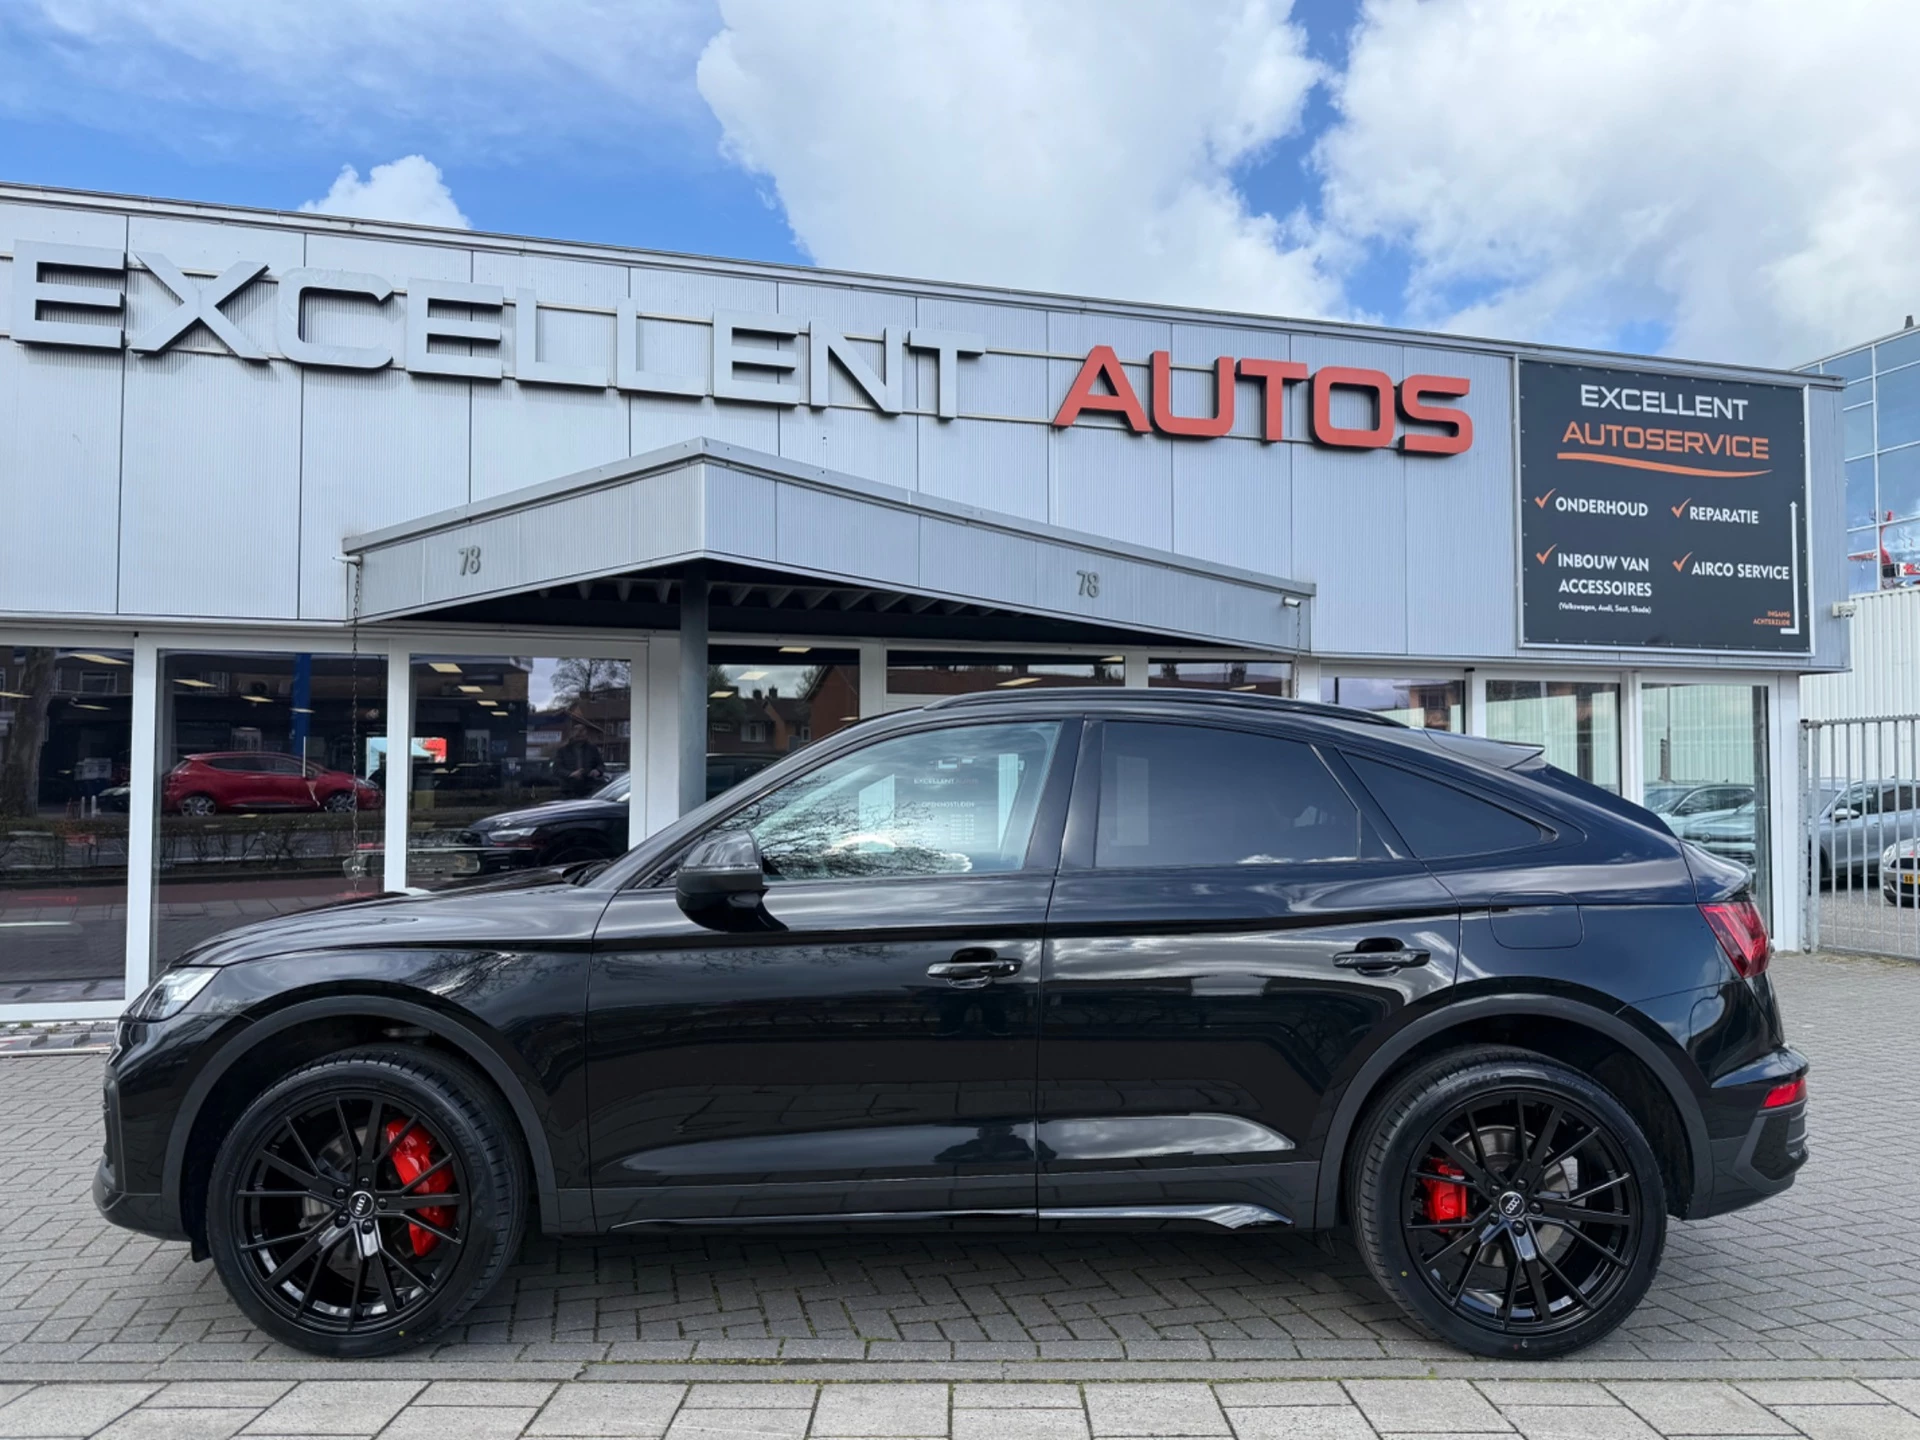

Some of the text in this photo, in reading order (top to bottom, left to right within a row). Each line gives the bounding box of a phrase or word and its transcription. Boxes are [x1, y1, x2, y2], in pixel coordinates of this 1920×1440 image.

[12, 239, 1473, 455] EXCELLENT AUTOS
[1580, 384, 1749, 421] EXCELLENT
[1562, 421, 1769, 460] AUTOSERVICE
[1555, 497, 1648, 517] ONDERHOUD
[1689, 506, 1759, 525] REPARATIE
[458, 546, 481, 576] 78
[1557, 553, 1650, 573] INBOUW VAN
[1691, 562, 1790, 580] AIRCO SERVICE
[1076, 570, 1100, 598] 78
[1558, 579, 1652, 598] ACCESSOIRES
